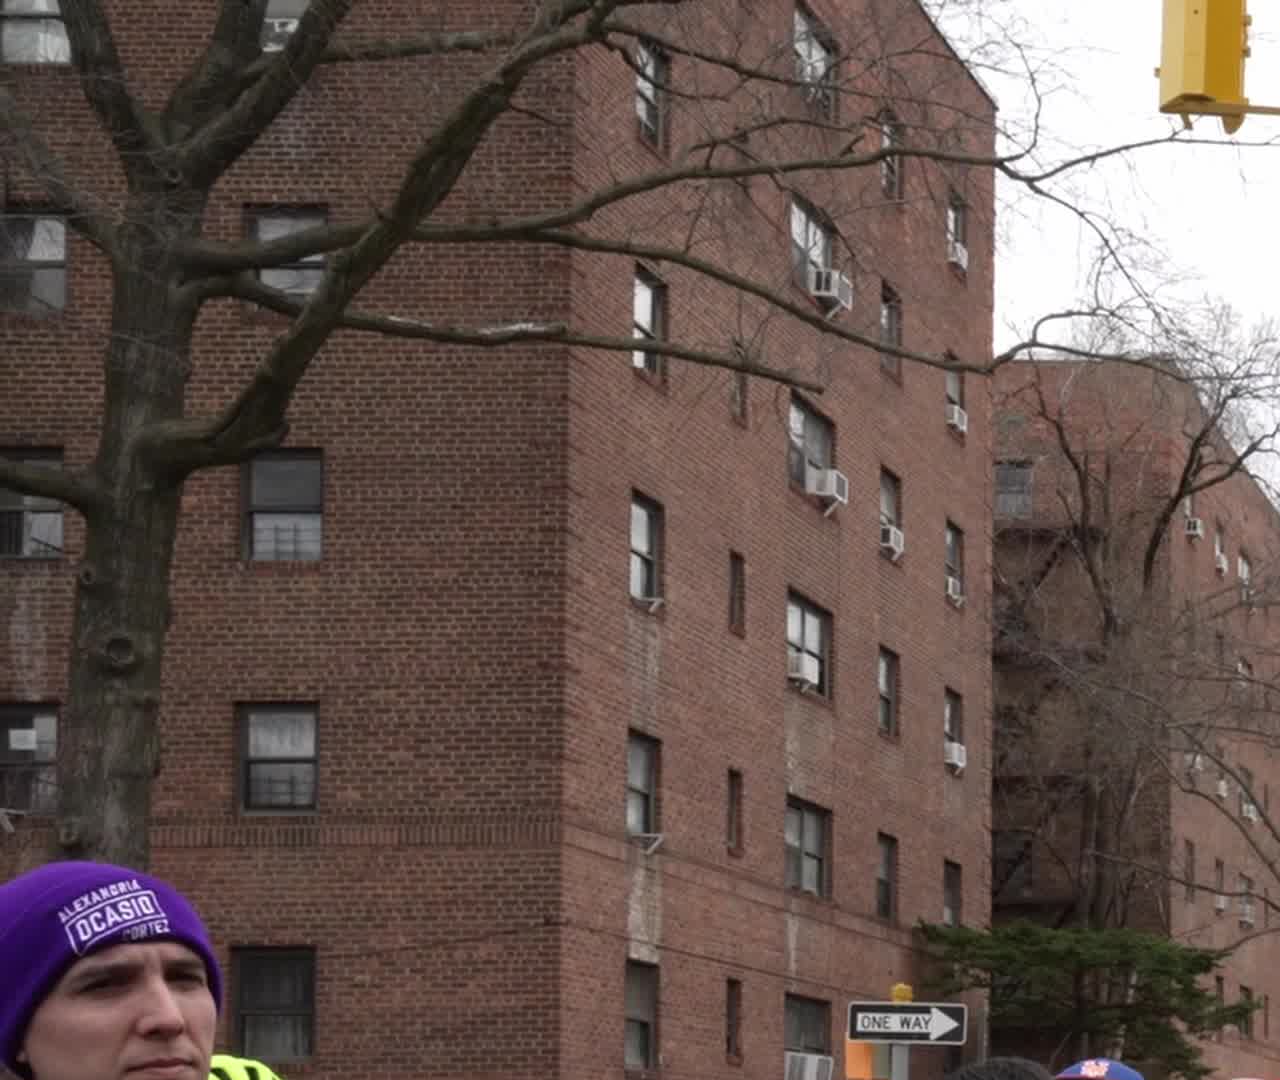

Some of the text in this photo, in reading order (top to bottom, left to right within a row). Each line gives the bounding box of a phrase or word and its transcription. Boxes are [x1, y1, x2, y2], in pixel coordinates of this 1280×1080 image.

[58, 880, 142, 922] ALEXANDRIA
[75, 895, 155, 941] OCASIO
[861, 1015, 932, 1030] ONE WAY
